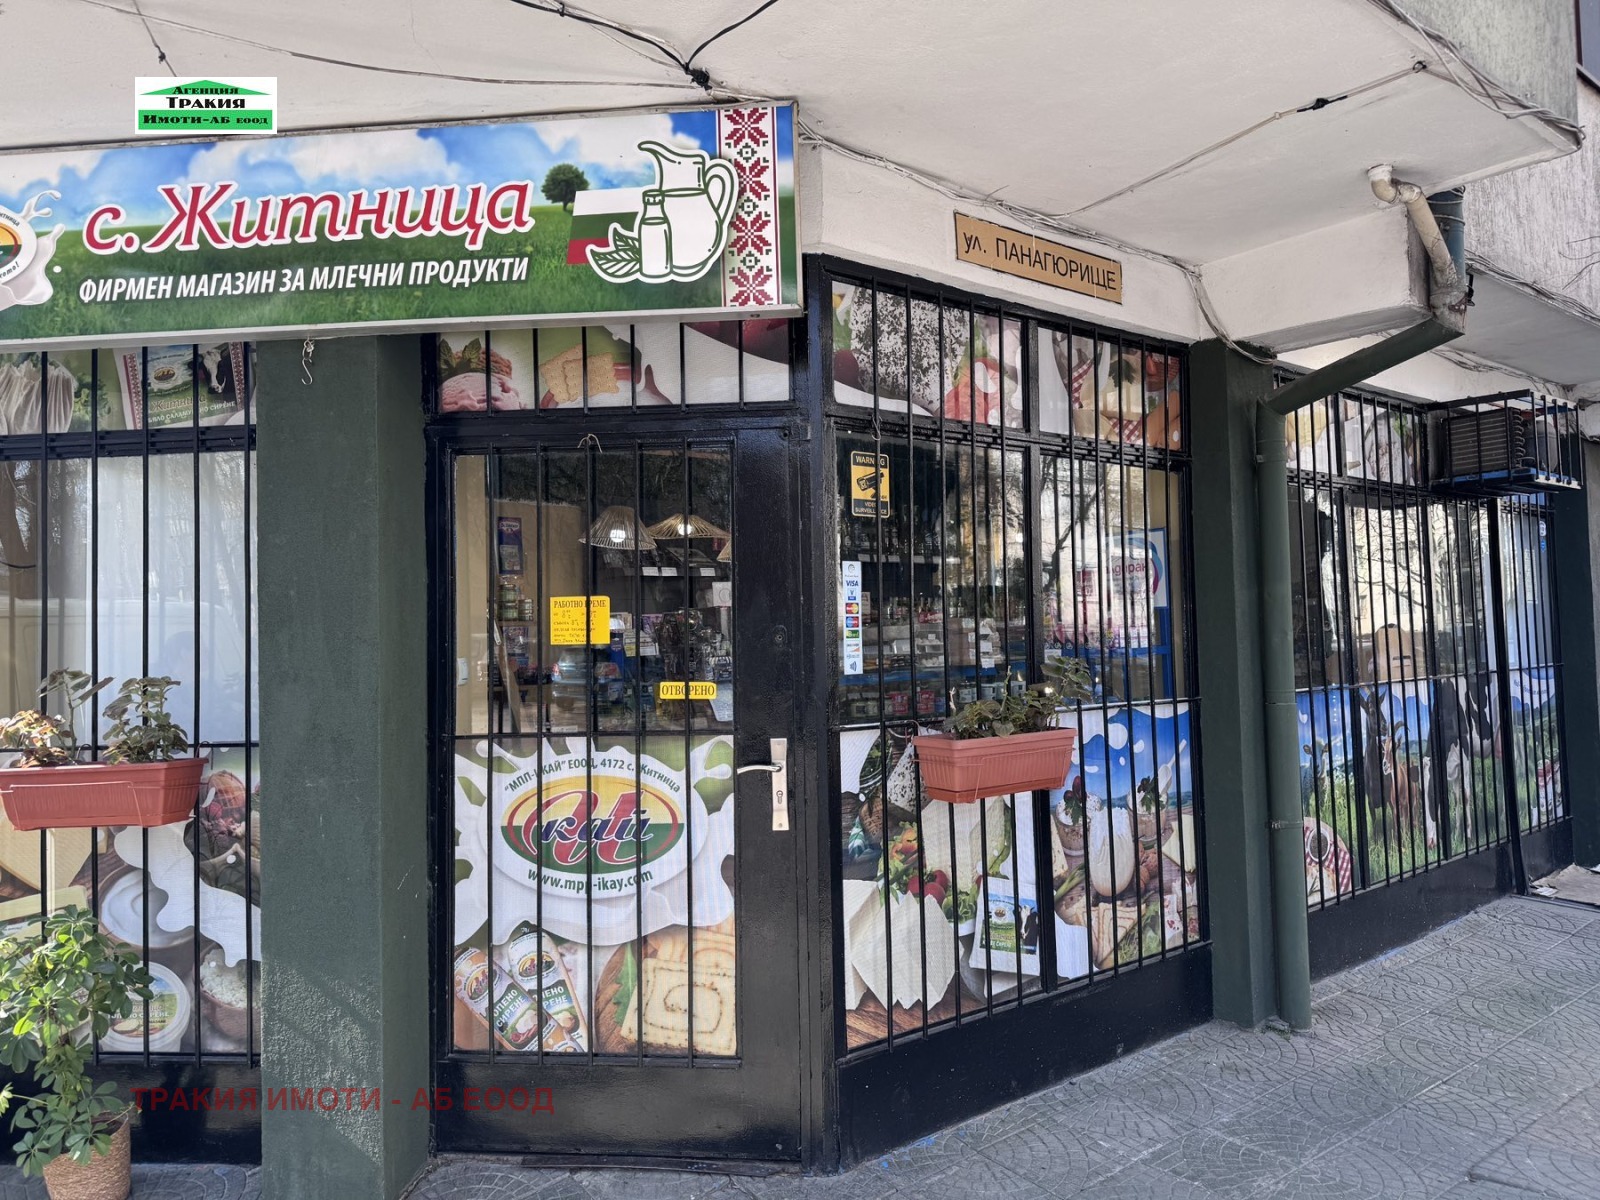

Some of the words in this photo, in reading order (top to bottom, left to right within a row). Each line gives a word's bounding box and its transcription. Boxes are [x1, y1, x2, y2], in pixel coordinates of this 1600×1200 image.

[0, 212, 20, 228] тница
[84, 206, 136, 251] с.
[145, 182, 531, 247] Житница
[963, 232, 987, 254] ул.
[996, 238, 1117, 290] ПАНАГЮРИЩЕ
[79, 276, 174, 303] ФИРМЕН
[176, 270, 277, 299] МАГАЗИН
[279, 268, 305, 292] ЗА
[309, 262, 405, 291] МЛЕЧНИ
[408, 257, 529, 288] ПРОДУКТИ
[151, 394, 207, 411] Житниа
[855, 455, 886, 466] WARNG
[854, 507, 887, 515] SURVEILLCE
[553, 600, 584, 609] РАБОТНО
[585, 599, 607, 608] РЕМЕ
[661, 684, 715, 696] ОТВОРЕНО
[600, 758, 625, 770] 4172
[527, 868, 653, 895] www.mp-ikay.cm
